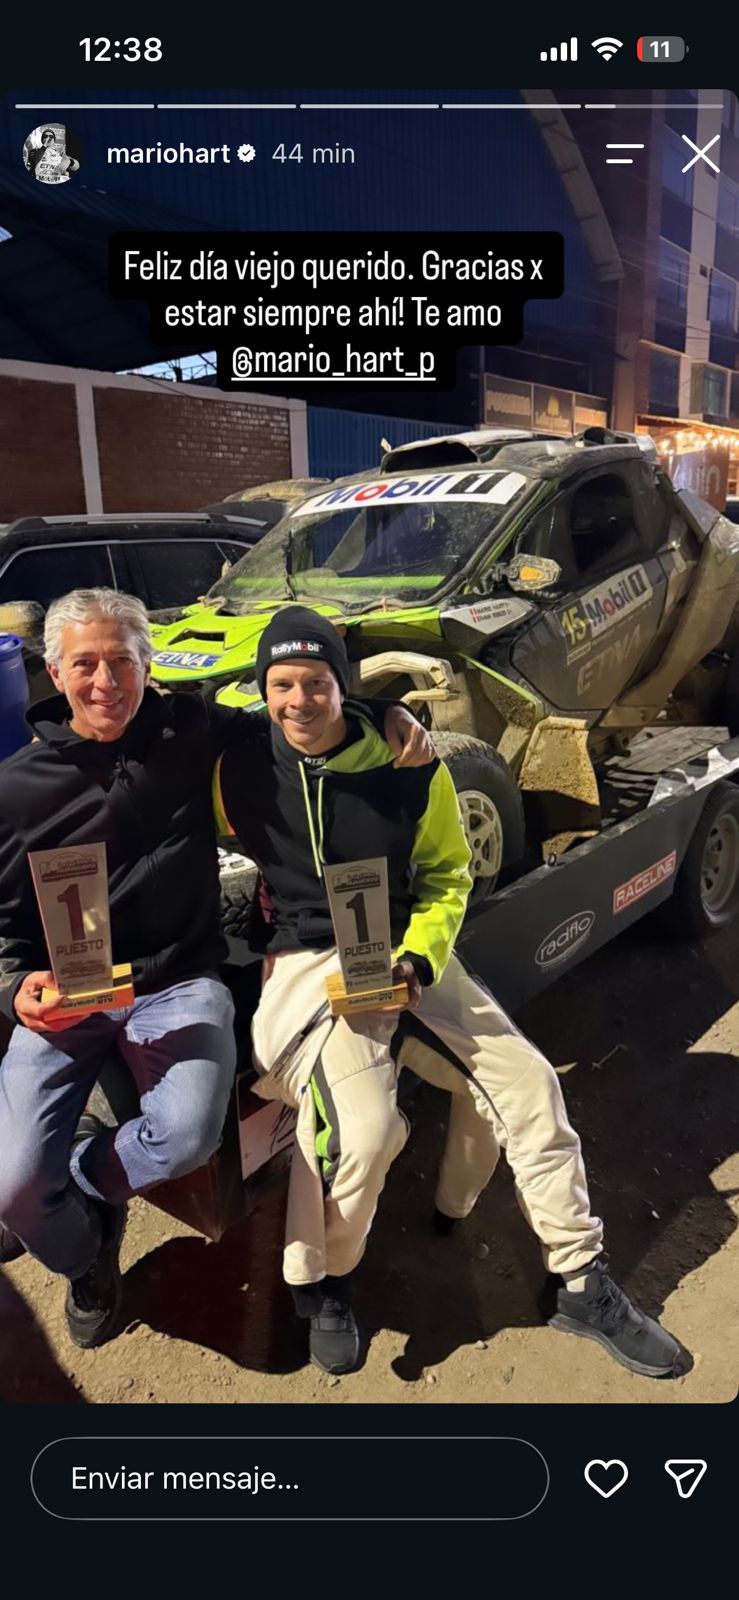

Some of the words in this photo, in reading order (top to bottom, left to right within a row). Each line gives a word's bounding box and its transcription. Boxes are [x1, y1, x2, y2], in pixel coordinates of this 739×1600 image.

[314, 474, 454, 508] Mobil
[585, 579, 634, 627] Mobil
[561, 606, 586, 645] 15
[271, 641, 320, 656] RallyMobil
[616, 857, 673, 908] RACELINE
[57, 883, 85, 941] 1
[346, 892, 370, 943] 1
[56, 938, 104, 957] PUESTO
[344, 941, 385, 959] PUESTO
[540, 917, 591, 961] radflo
